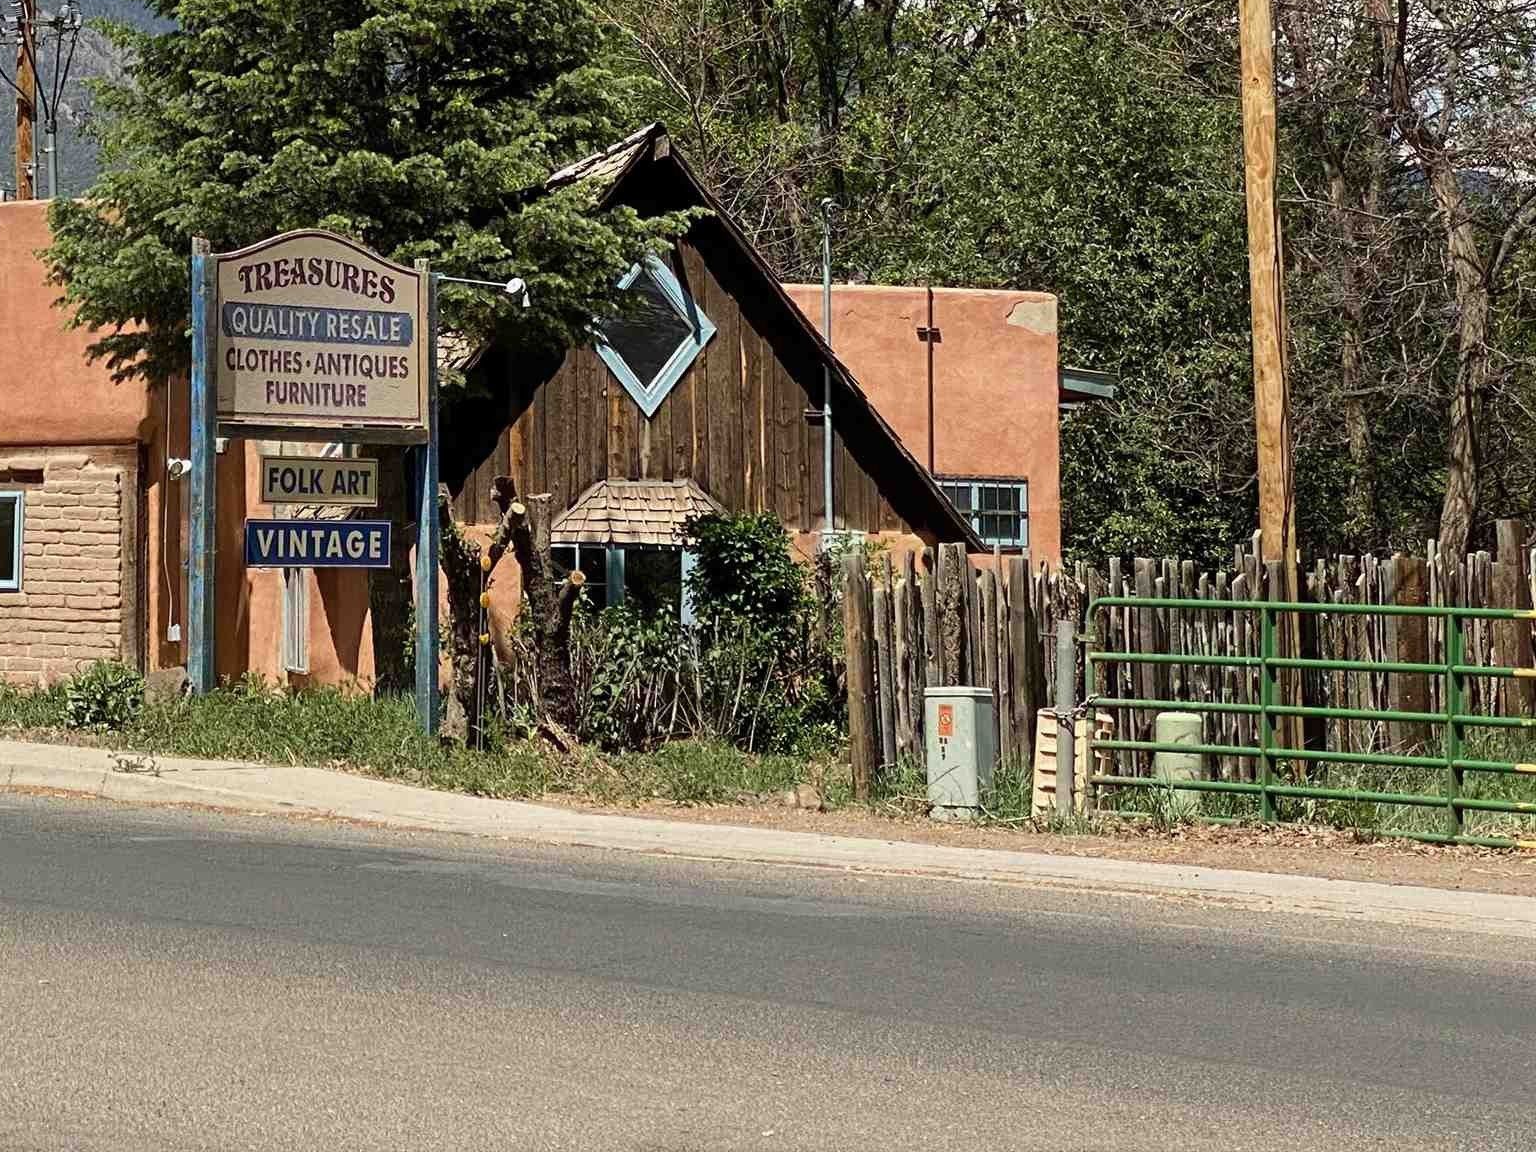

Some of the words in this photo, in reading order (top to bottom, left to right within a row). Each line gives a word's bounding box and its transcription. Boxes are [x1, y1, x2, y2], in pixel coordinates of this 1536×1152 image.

[238, 257, 396, 304] TREASURES
[231, 305, 320, 336] QUALITY
[326, 311, 401, 342] RESALE
[225, 347, 302, 374] CLOTHES
[314, 352, 409, 380] ANTIQUES
[266, 380, 368, 407] FURNITURE
[268, 467, 323, 495] FOLK
[332, 469, 372, 496] ART
[256, 529, 382, 558] VINTAGE
